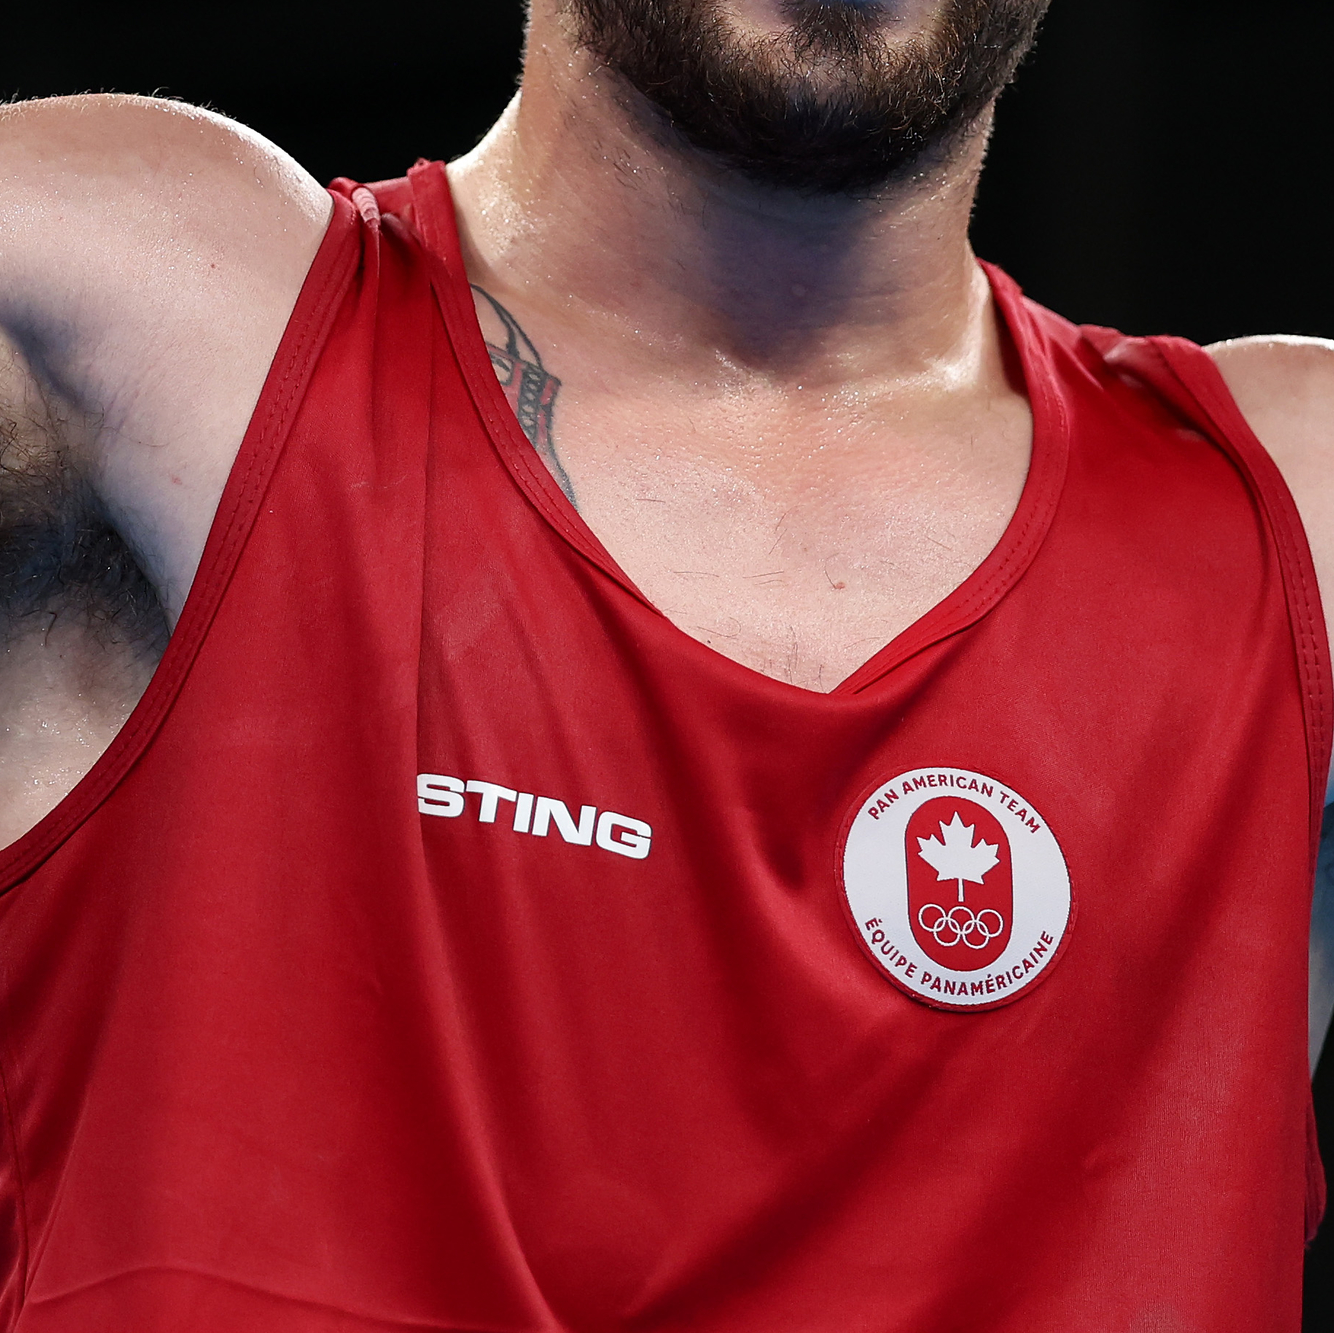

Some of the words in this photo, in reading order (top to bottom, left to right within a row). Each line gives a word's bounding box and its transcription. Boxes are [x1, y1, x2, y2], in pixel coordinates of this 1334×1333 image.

[417, 773, 652, 860] STING
[867, 789, 899, 820] PAN
[901, 774, 994, 798] AMERICAN
[999, 790, 1041, 834] TEAM
[864, 917, 918, 979] ÉQUIPE
[920, 930, 1054, 997] PANAMÉRICAINE
